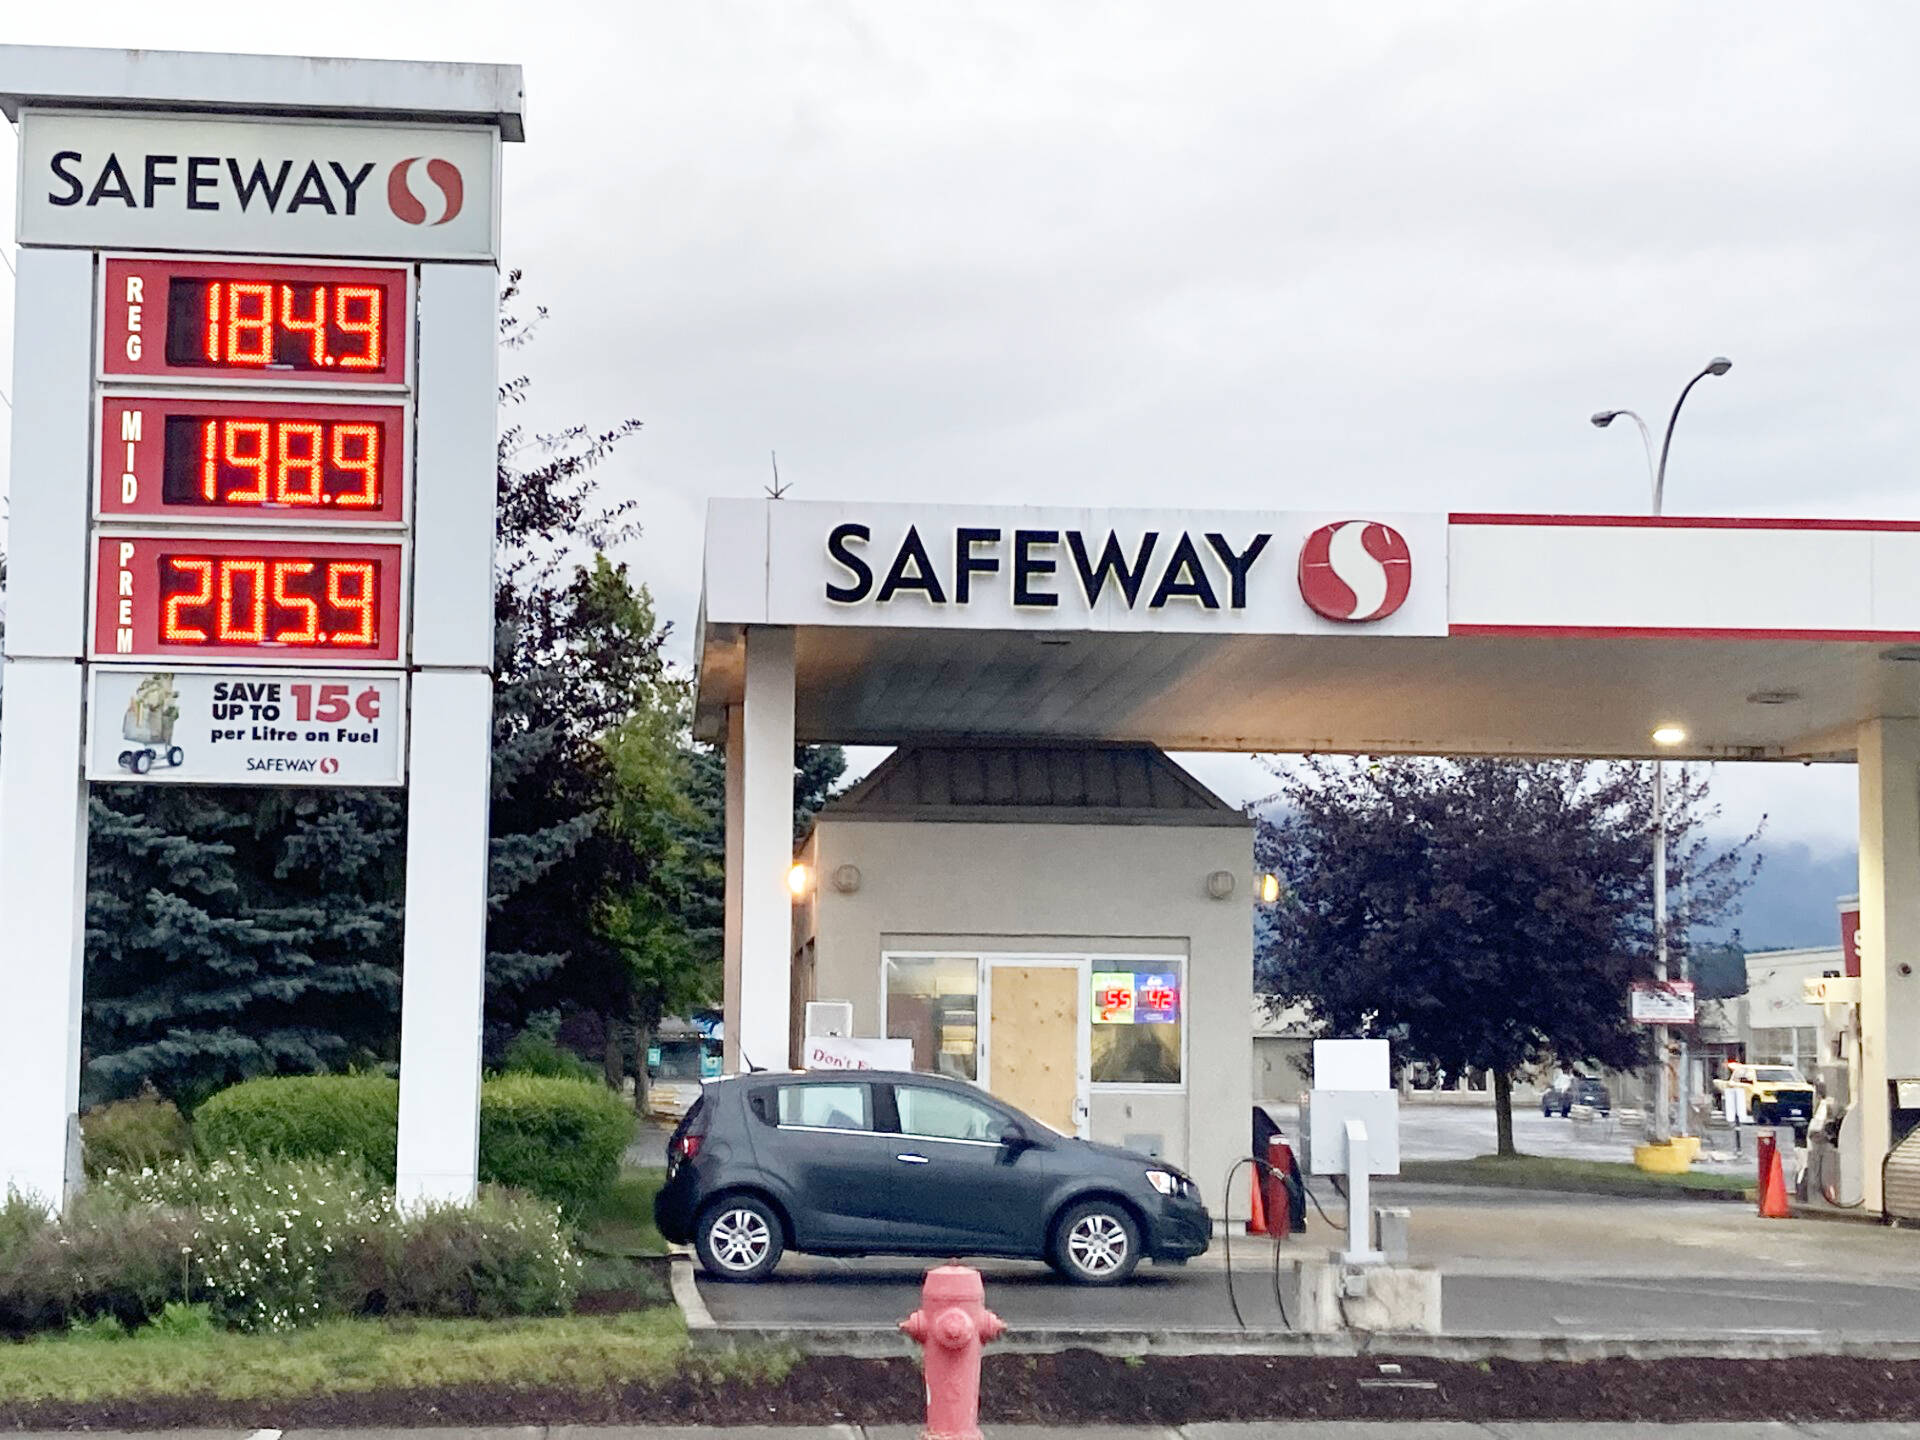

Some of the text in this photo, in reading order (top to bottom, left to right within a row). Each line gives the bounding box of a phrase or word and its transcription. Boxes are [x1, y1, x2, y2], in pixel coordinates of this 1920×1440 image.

[49, 151, 376, 216] SAFEWAY
[127, 276, 144, 361] REG
[207, 282, 381, 367] 184.9
[121, 411, 142, 504] MID
[203, 420, 379, 506] 198.9
[117, 542, 135, 653] PREM
[165, 558, 374, 644] 205.9
[825, 523, 1273, 611] SAFEWAY
[212, 704, 280, 721] UP TO
[214, 682, 281, 702] SAVE
[291, 684, 380, 723] 15¢
[211, 726, 379, 743] per Litre on Fuel
[246, 758, 317, 772] SAFEWAY
[813, 1048, 853, 1069] Don't
